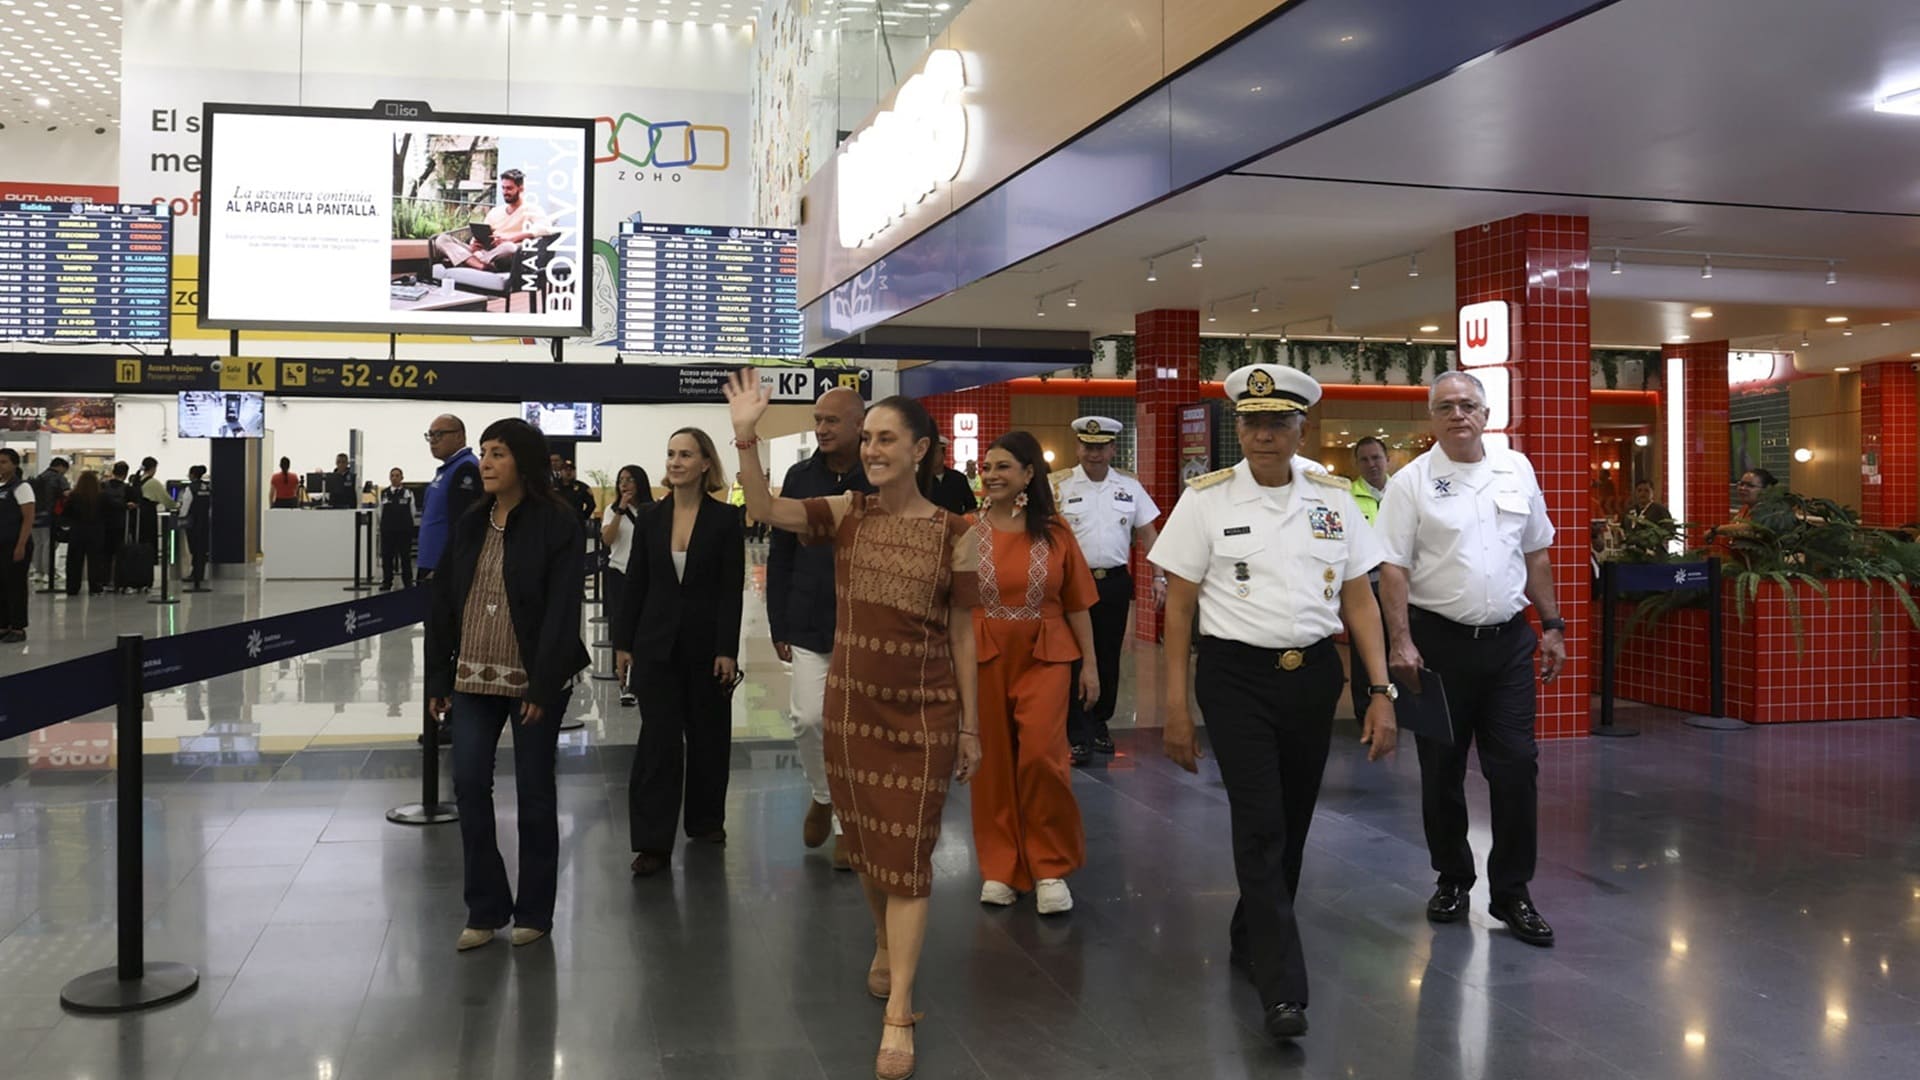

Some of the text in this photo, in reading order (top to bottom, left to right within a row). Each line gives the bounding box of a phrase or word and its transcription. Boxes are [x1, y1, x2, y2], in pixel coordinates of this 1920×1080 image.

[400, 104, 418, 116] isa
[152, 109, 177, 132] El
[152, 152, 201, 172] me
[618, 171, 682, 182] ZOHO
[4, 194, 94, 204] OUTLANDER
[233, 185, 373, 202] La aventura continúa
[226, 200, 380, 217] AL APAGAR LA PANTALLA.
[546, 140, 578, 312] BONVOY
[247, 362, 262, 385] K
[340, 364, 370, 387] 52
[389, 365, 418, 388] 62
[680, 369, 699, 377] Acceso
[685, 377, 718, 386] tripulación
[761, 375, 774, 383] Sala
[779, 374, 808, 394] KP
[11, 408, 47, 416] VIAJE
